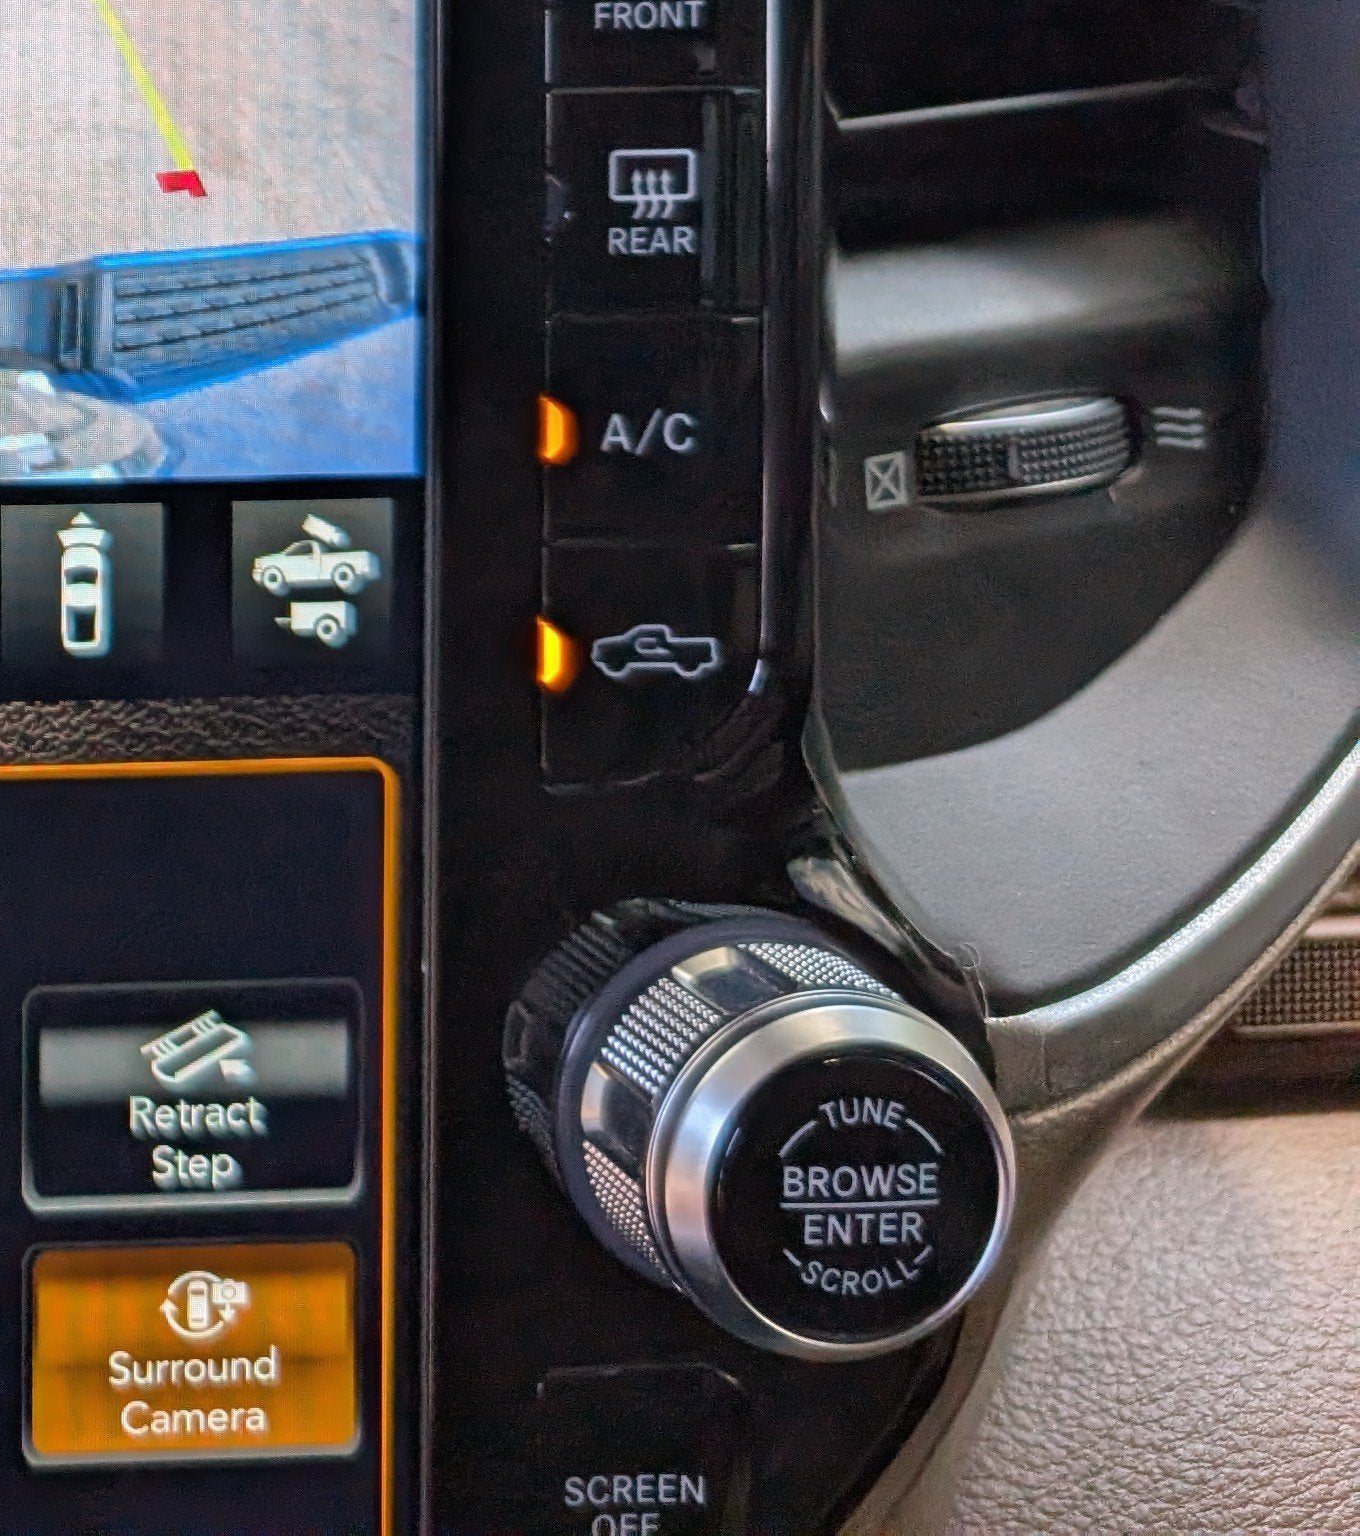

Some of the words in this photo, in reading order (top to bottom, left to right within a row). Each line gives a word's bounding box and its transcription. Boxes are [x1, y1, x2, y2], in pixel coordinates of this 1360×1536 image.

[594, 1, 705, 31] FRONT
[608, 227, 696, 256] REAR
[602, 413, 696, 453] A/C
[129, 1097, 264, 1136] Retract
[819, 1098, 907, 1129] TUNE
[152, 1146, 238, 1190] Step
[782, 1163, 940, 1197] BROWSE
[804, 1214, 925, 1247] ENTER
[799, 1260, 920, 1297] SCROLL
[109, 1346, 279, 1387] Surround
[121, 1403, 267, 1437] Camera
[564, 1474, 706, 1507] SCREEN
